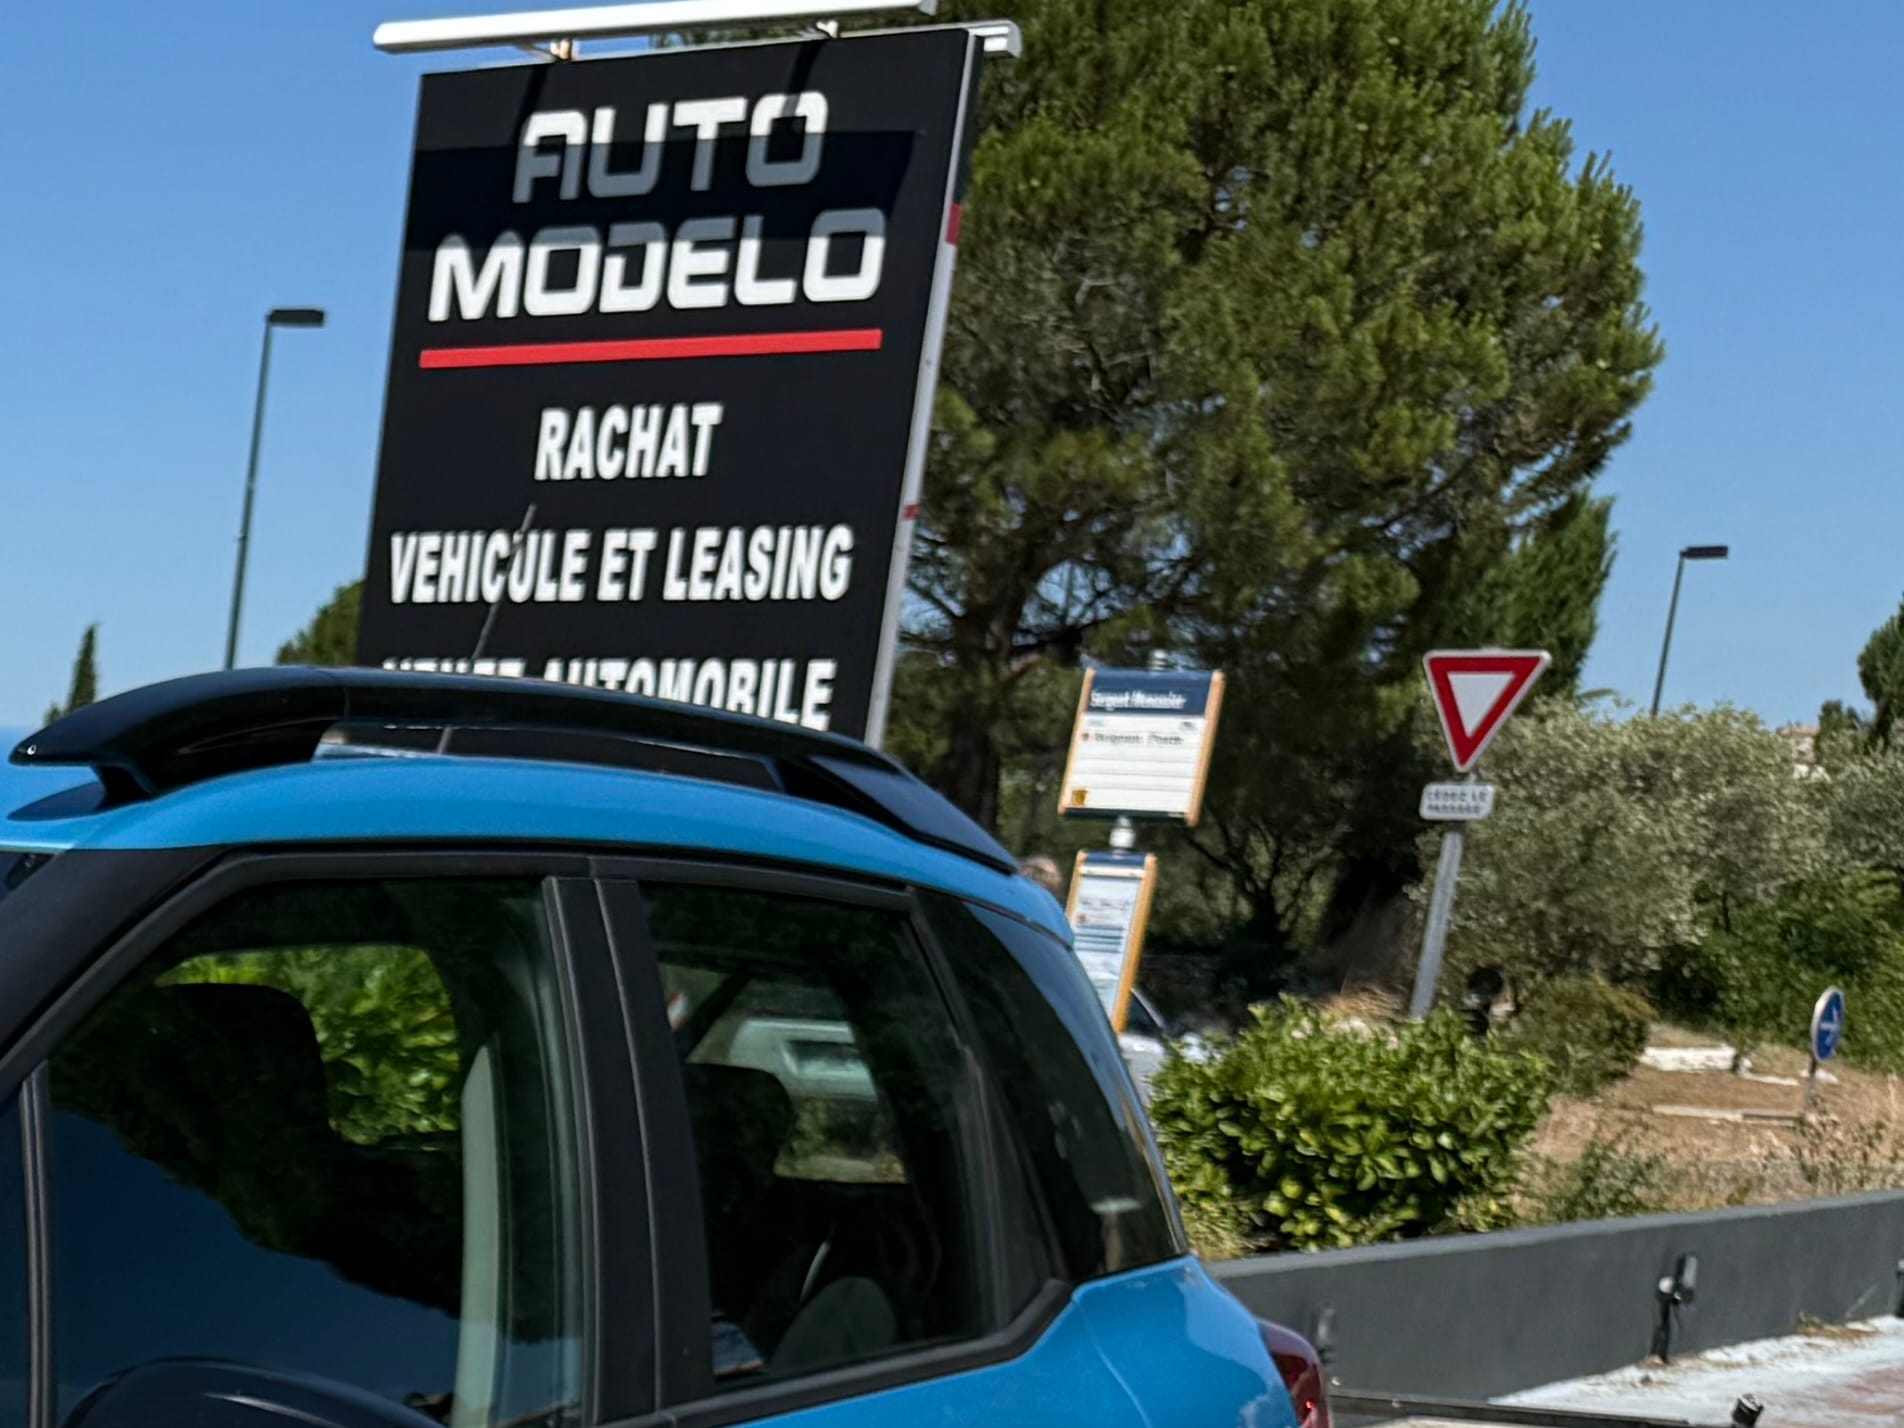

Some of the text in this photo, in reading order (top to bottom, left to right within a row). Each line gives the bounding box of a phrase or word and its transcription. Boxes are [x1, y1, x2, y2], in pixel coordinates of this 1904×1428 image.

[512, 90, 830, 204] AUTO
[428, 207, 886, 323] MODELO
[534, 402, 723, 481] RACHAT
[390, 524, 855, 605] VEHICULE ET LEASING
